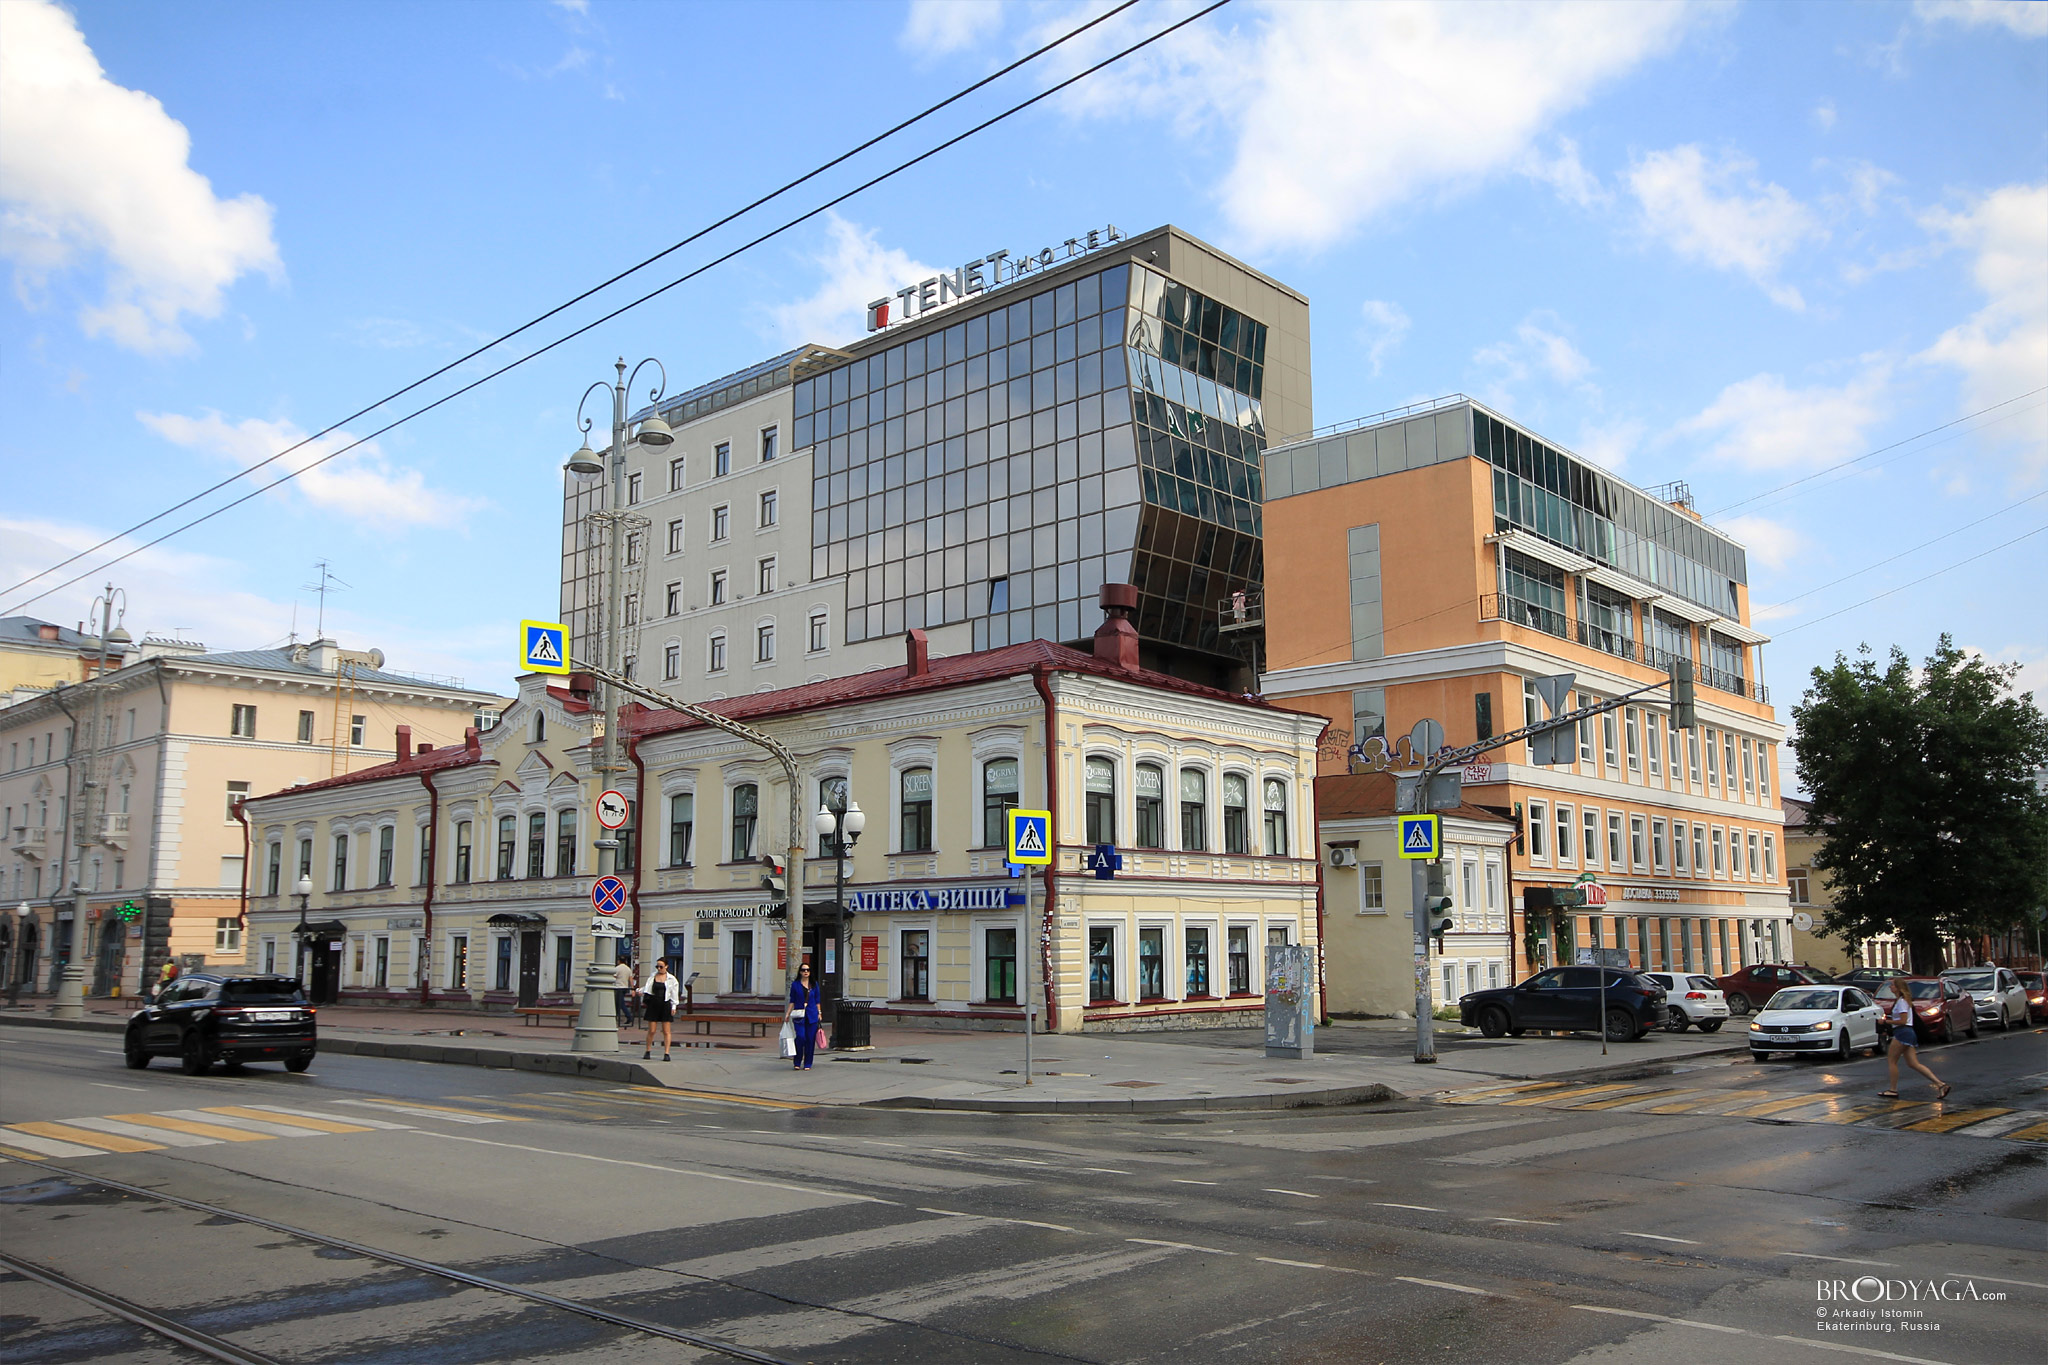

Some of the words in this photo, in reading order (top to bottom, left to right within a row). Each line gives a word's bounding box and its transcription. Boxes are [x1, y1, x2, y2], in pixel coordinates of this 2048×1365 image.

[897, 249, 1010, 318] TENET
[1017, 224, 1121, 275] HOTEL
[996, 768, 1017, 777] GRIVA
[1093, 767, 1111, 777] GRIVA
[1135, 770, 1161, 789] SCREEN
[849, 889, 931, 912] АПТЕКА
[937, 887, 1008, 910] ВИШИ
[695, 908, 718, 919] САЛОН
[719, 907, 753, 918] КРАСОТЫ
